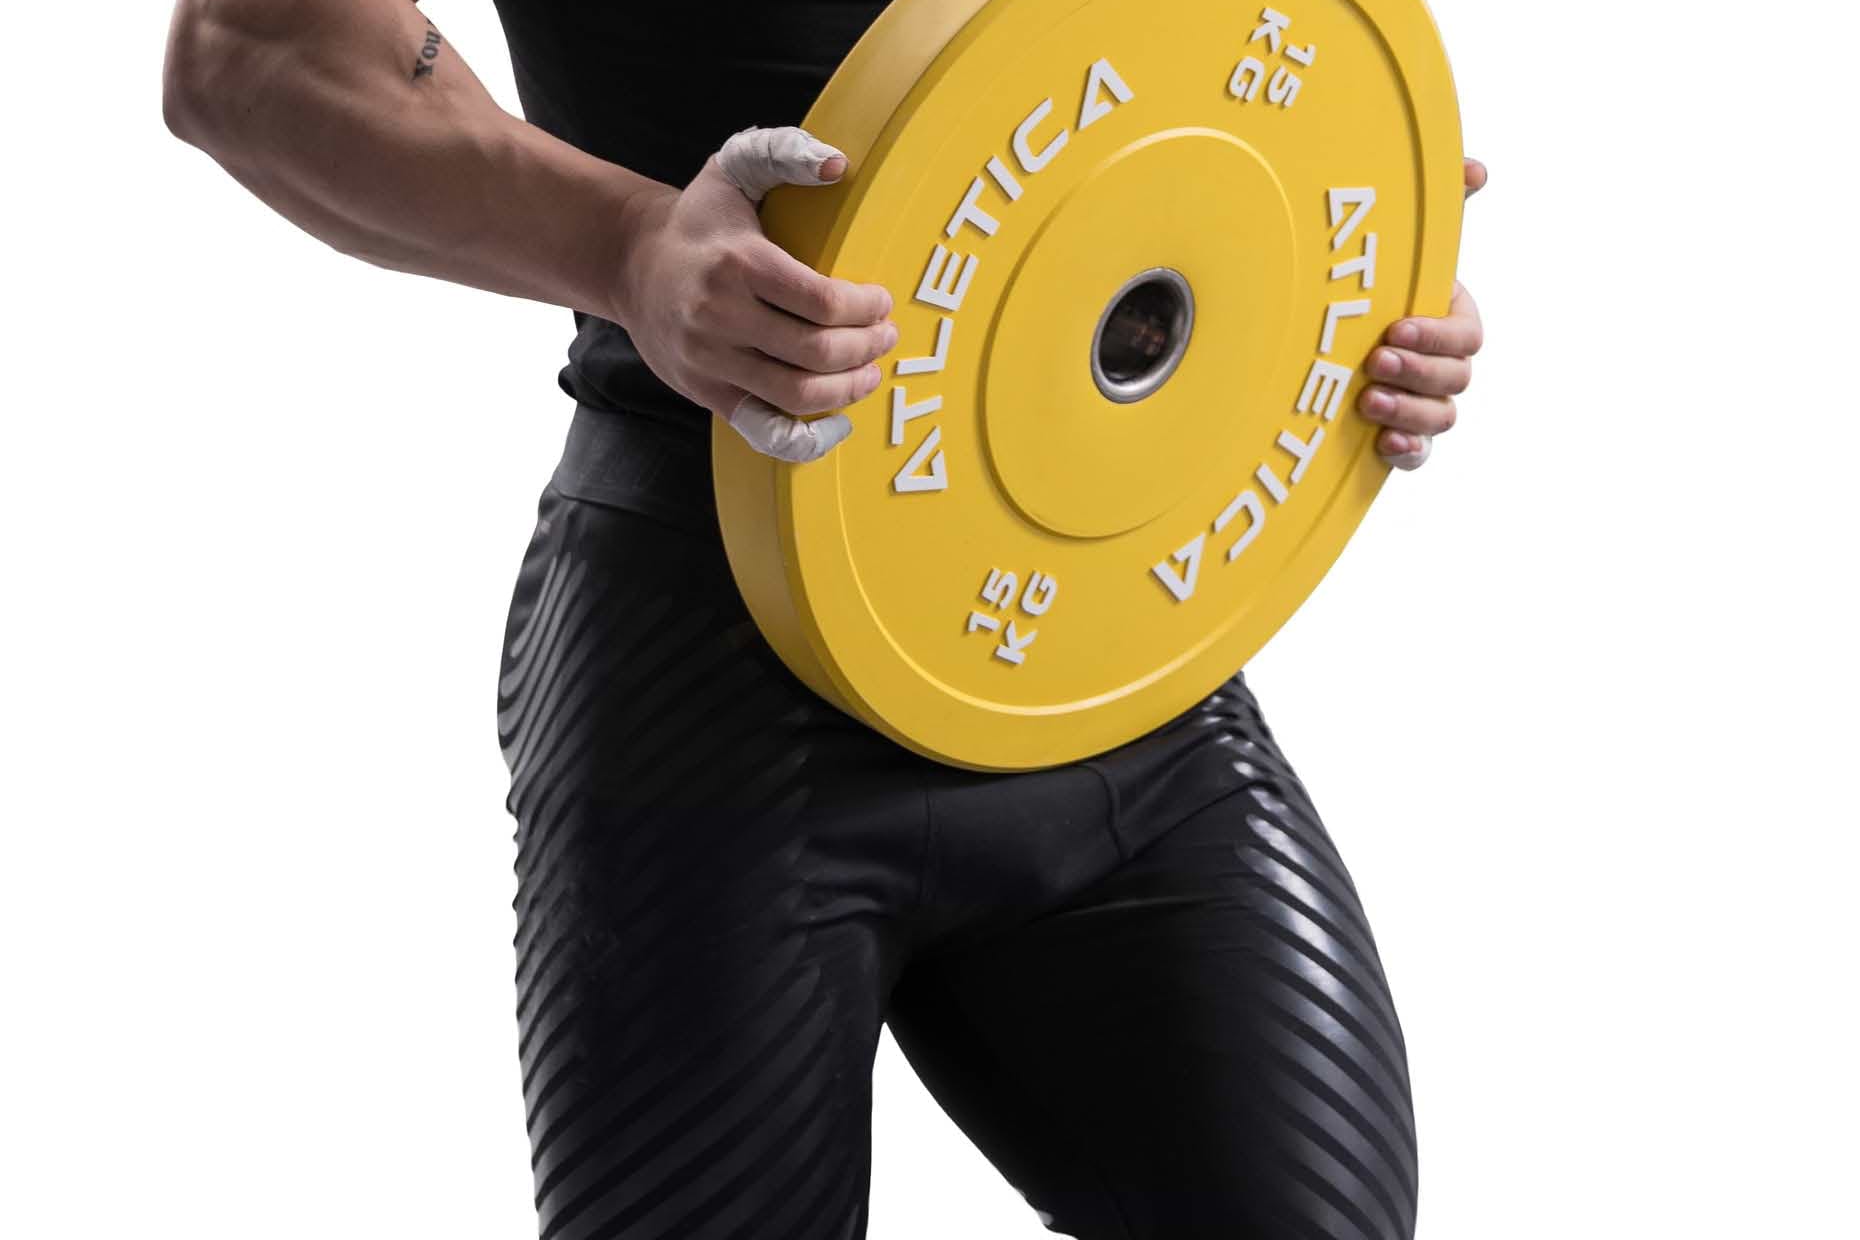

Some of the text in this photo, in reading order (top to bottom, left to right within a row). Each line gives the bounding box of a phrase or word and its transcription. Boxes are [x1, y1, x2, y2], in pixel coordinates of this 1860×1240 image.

[414, 17, 442, 79] You
[1228, 7, 1291, 102] KG
[1266, 43, 1316, 107] 15
[891, 57, 1135, 492] ATLETICA
[1150, 187, 1377, 601] ATLETICA
[967, 567, 1018, 632] 15
[995, 570, 1058, 664] KG
